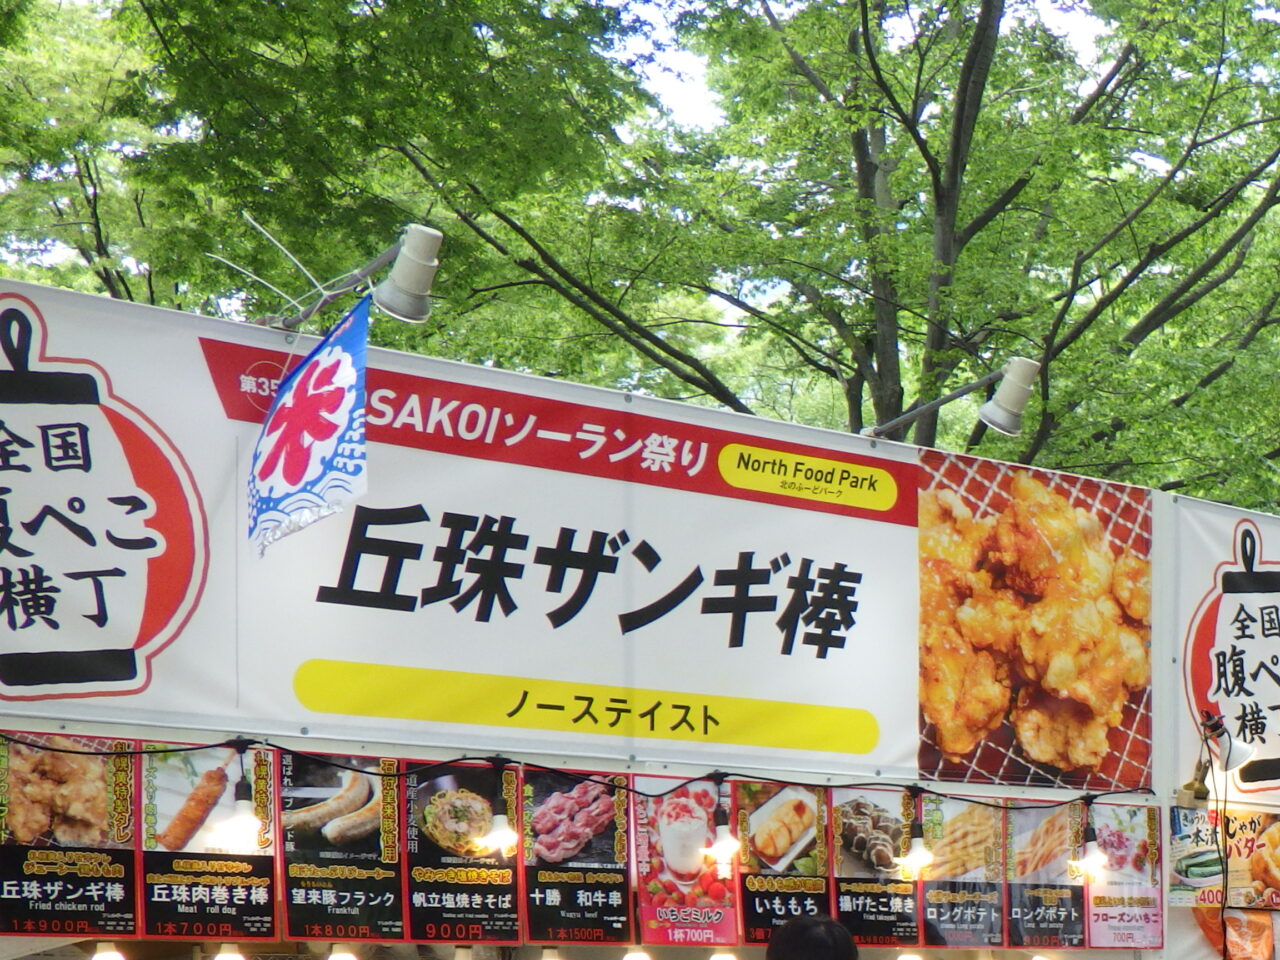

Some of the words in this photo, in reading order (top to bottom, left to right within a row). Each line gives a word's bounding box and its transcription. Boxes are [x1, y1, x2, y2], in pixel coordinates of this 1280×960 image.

[239, 374, 282, 397] 第35
[366, 389, 709, 477] SAKOIソーラン祭り
[0, 420, 91, 472] 全国
[737, 452, 788, 477] North
[792, 461, 834, 484] Food
[838, 469, 878, 492] Park
[779, 479, 843, 499] 北のふーどパーク
[315, 503, 863, 659] 丘珠ザンギ棒
[0, 566, 126, 631] 横丁
[505, 689, 720, 736] ノーステイスト
[1225, 813, 1262, 837] じゃが
[1177, 826, 1220, 847] 一本漬
[1226, 836, 1268, 860] バター
[0, 879, 126, 903] 丘珠ザンギ棒
[152, 884, 269, 906] 丘珠肉巻き棒
[291, 888, 395, 907] 望来豚フランク
[412, 892, 512, 910] 帆立塩焼きそば
[576, 889, 623, 908] 和牛串
[29, 900, 52, 911] Fried
[54, 901, 88, 912] chicken
[90, 902, 105, 912] rod
[177, 904, 198, 914] Meat
[222, 905, 237, 915] dog
[656, 906, 724, 924] いちごミルク
[754, 895, 819, 917] いももち
[838, 894, 915, 915] 揚げたこ焼き
[926, 906, 1000, 922] ロングポテト
[1011, 906, 1079, 922] ロングポテト
[1092, 912, 1160, 924] フローズンいちご
[425, 922, 484, 940] 900円
